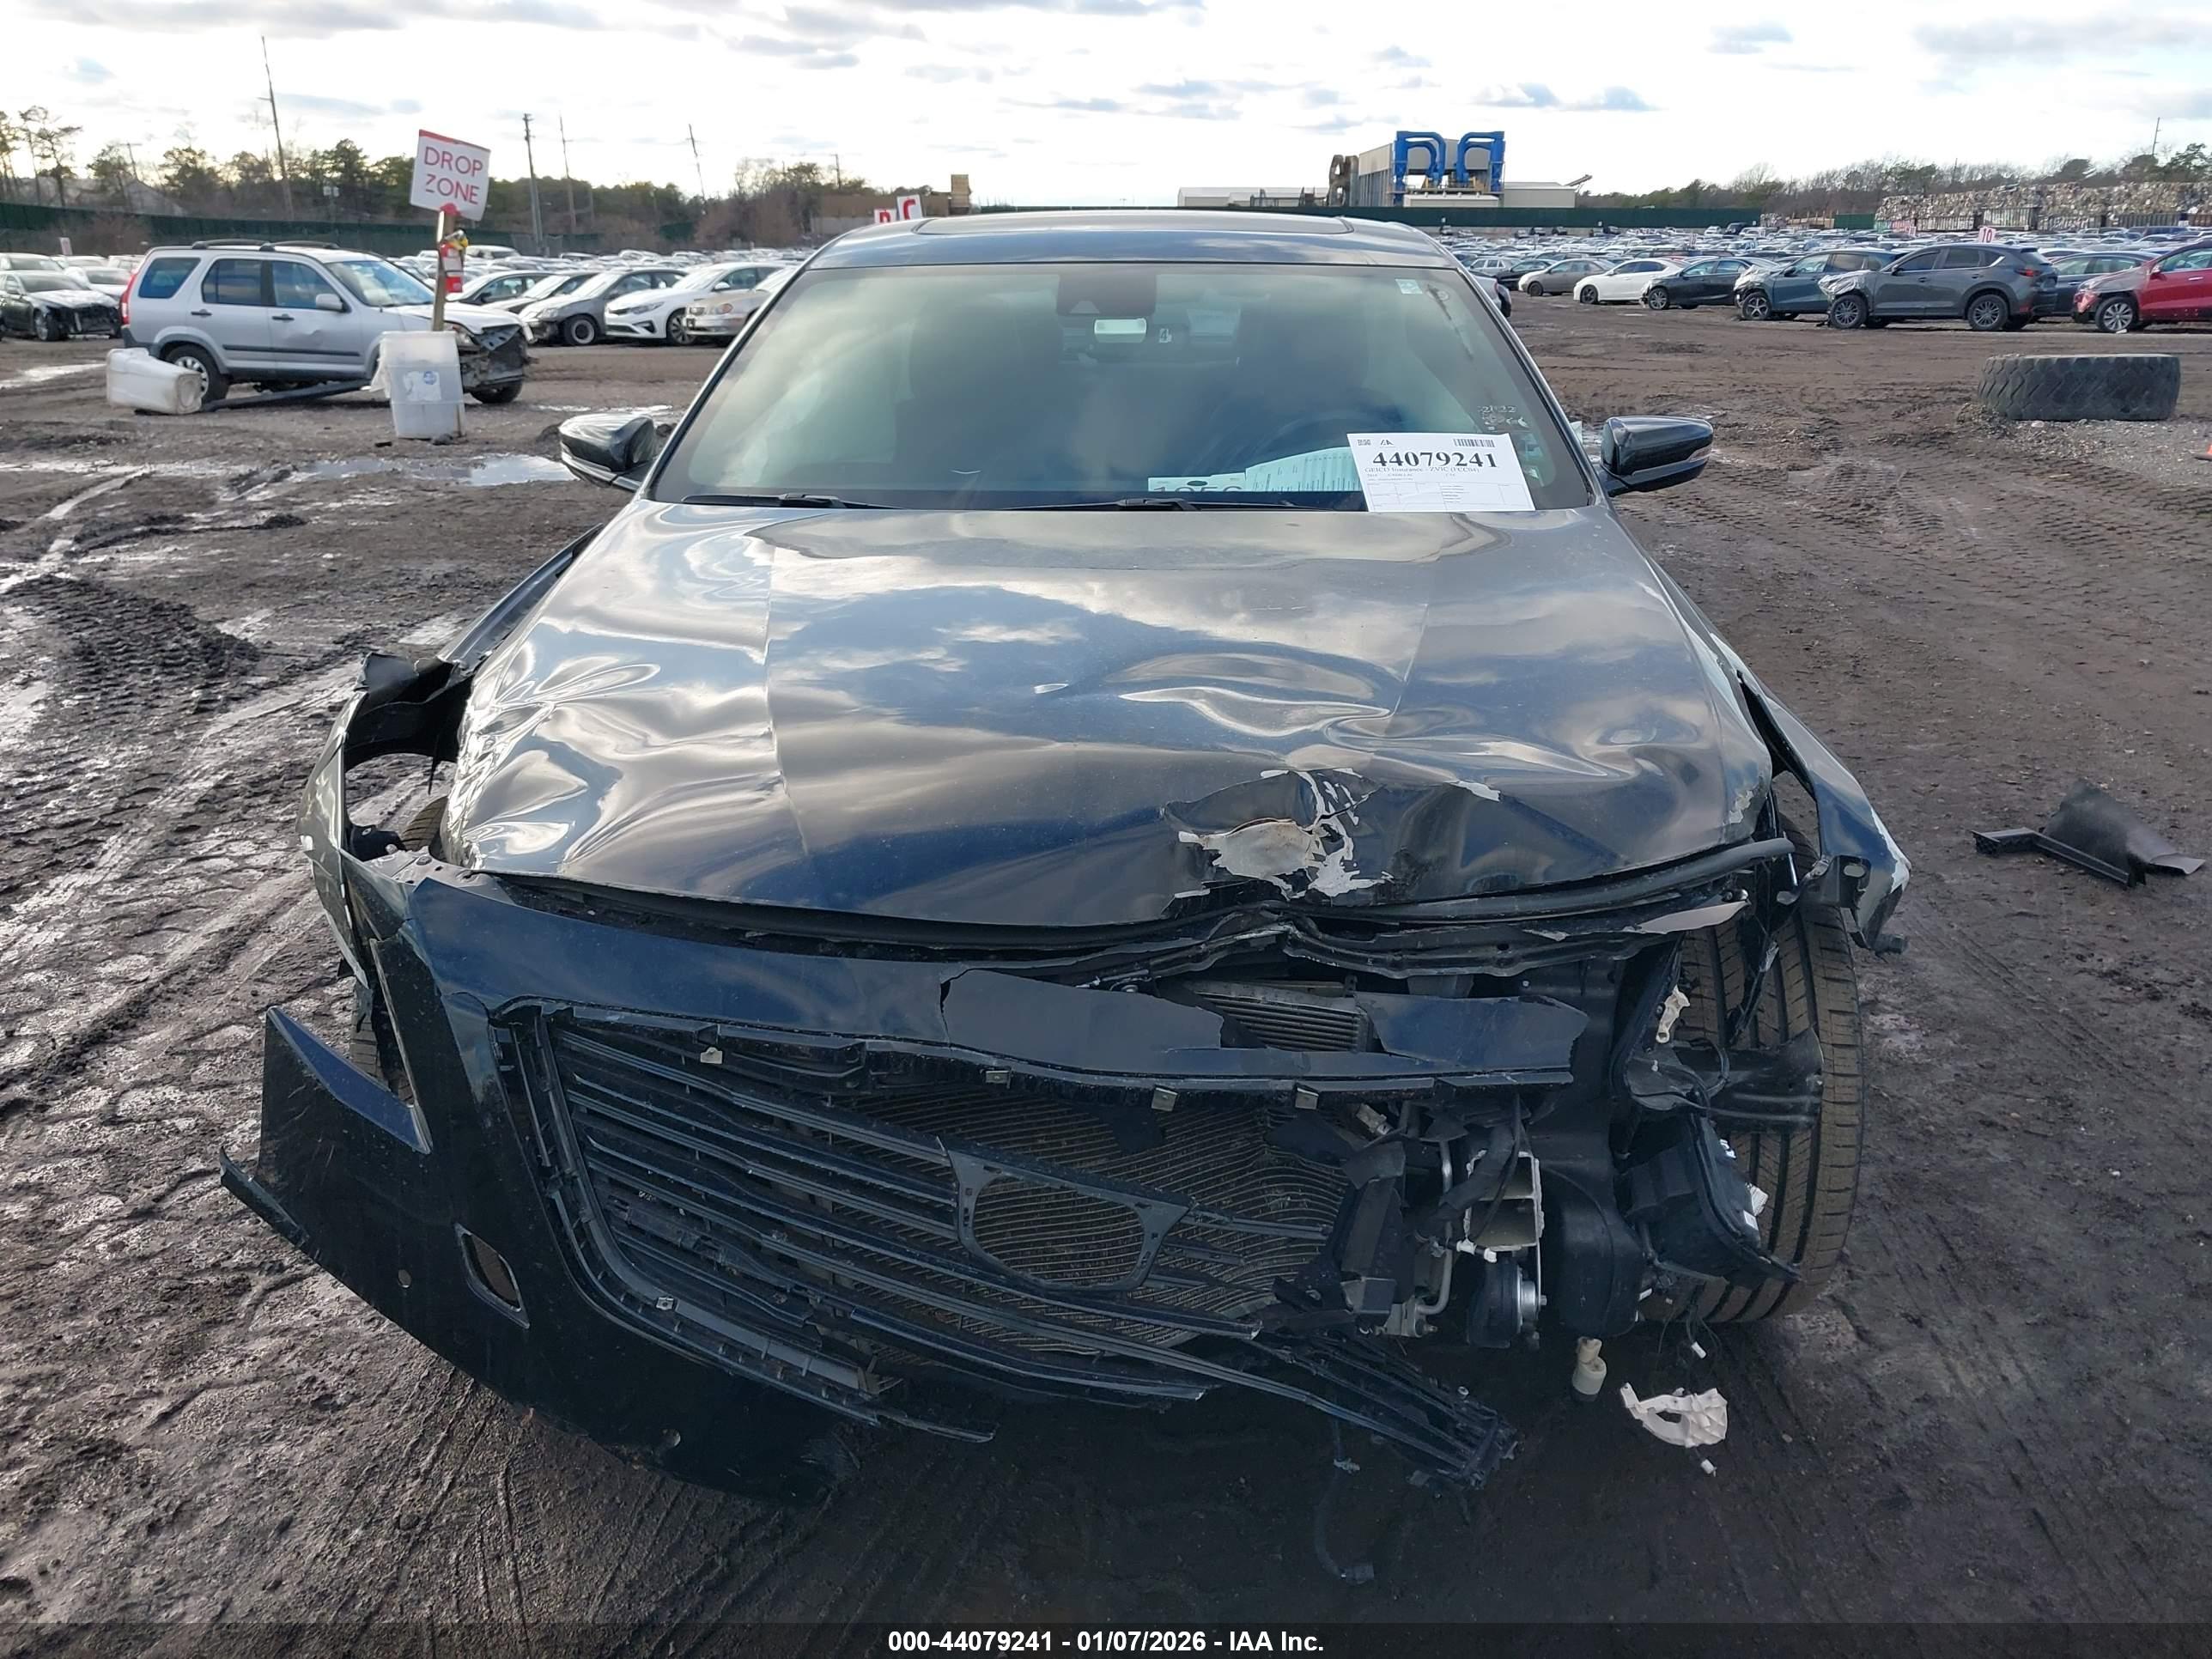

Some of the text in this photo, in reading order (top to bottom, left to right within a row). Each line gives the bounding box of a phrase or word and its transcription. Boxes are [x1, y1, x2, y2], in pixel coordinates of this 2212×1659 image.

[424, 146, 483, 177] DROP
[425, 173, 480, 205] ZONE
[1372, 452, 1498, 468] 44079241
